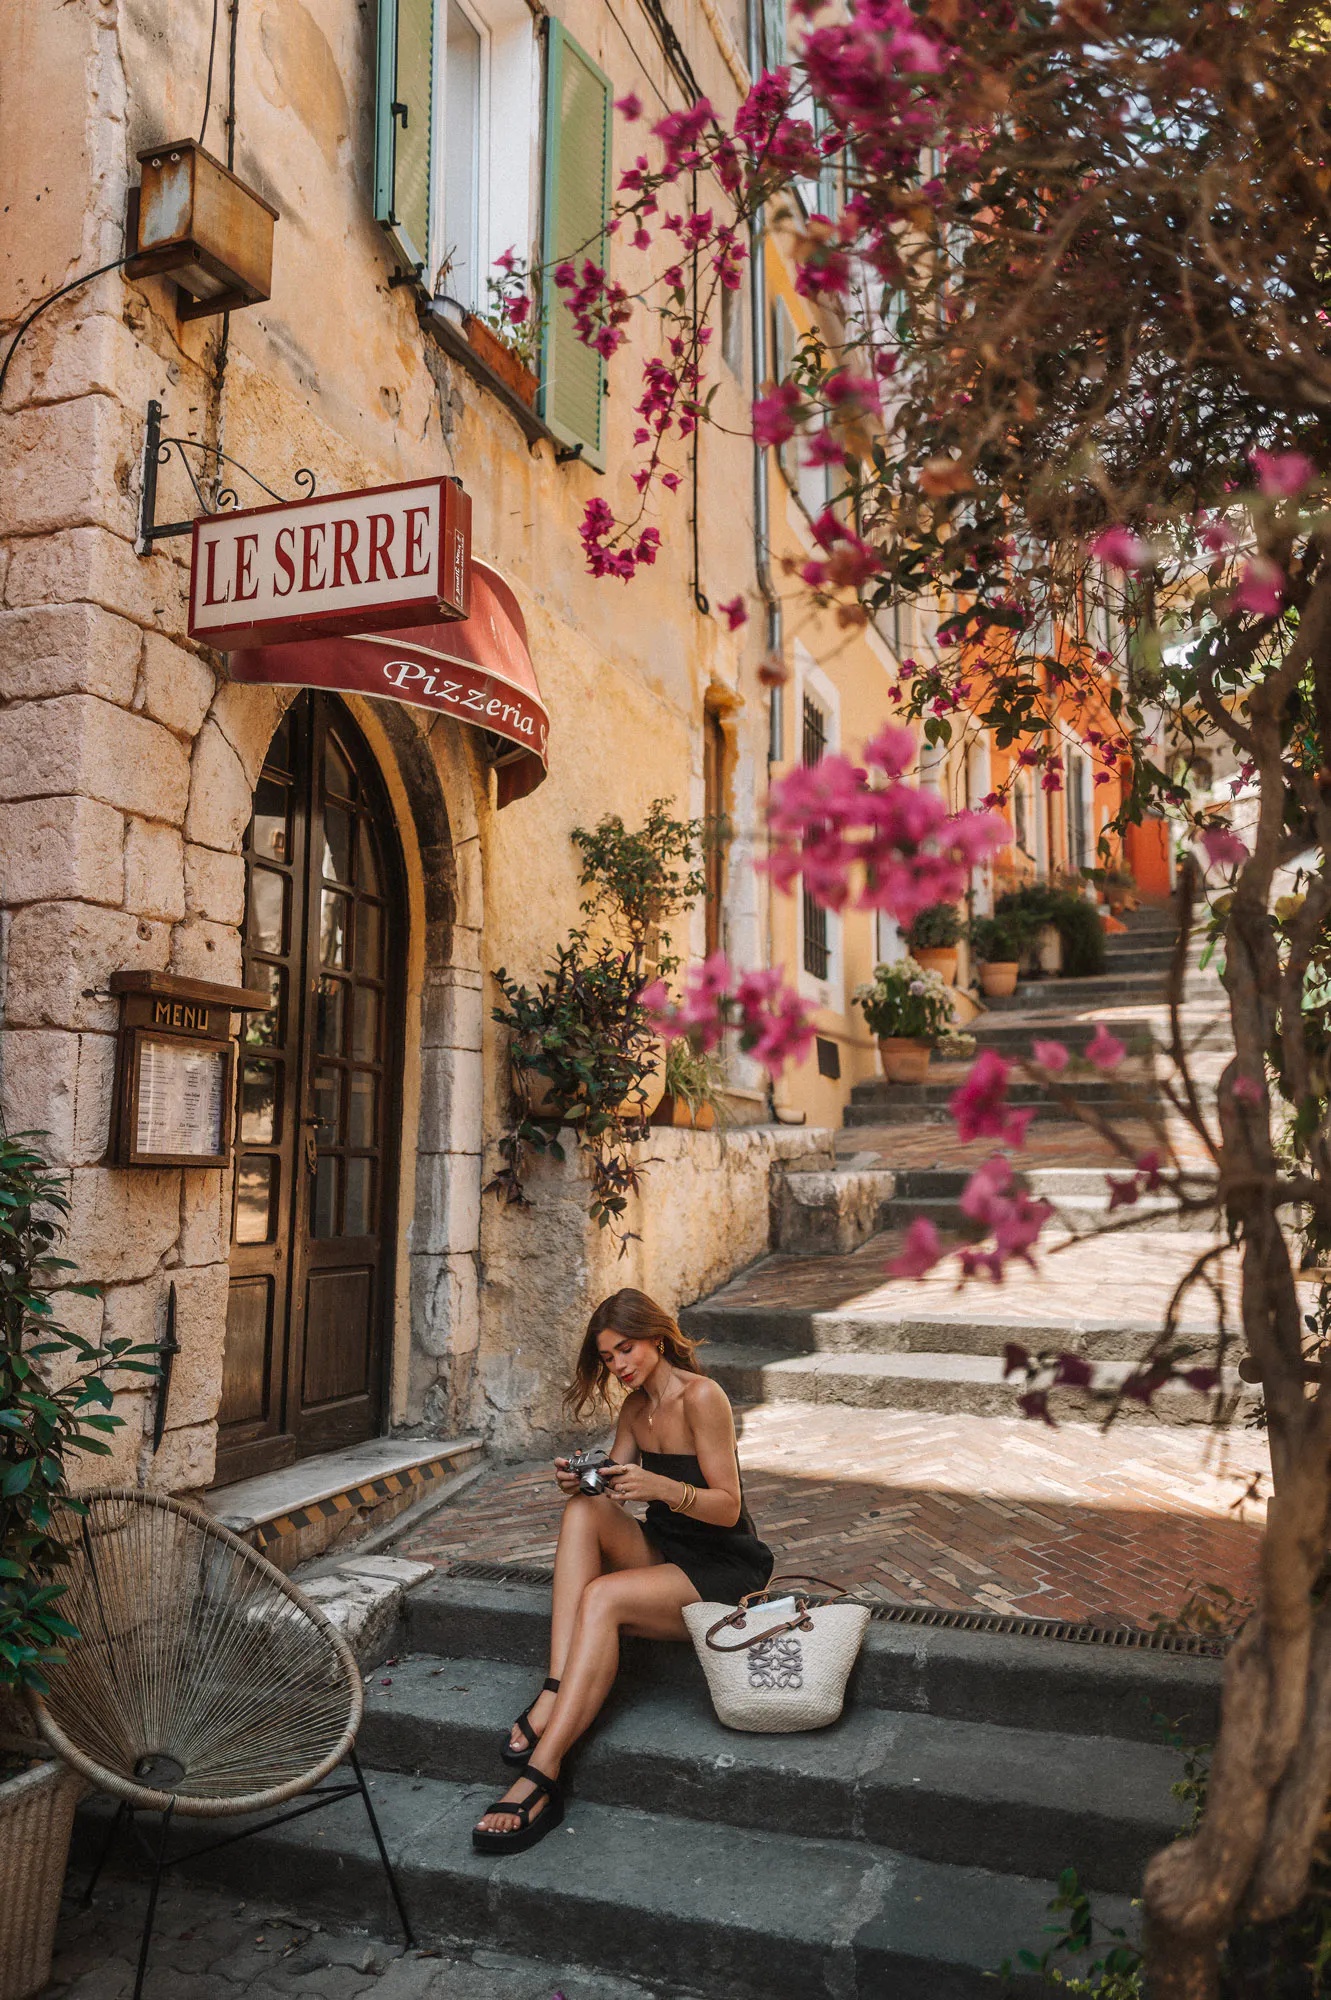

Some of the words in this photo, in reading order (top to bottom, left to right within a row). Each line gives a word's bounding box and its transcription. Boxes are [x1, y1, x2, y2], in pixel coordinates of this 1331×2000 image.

[202, 533, 259, 607] LE
[273, 506, 431, 598] SERRE
[383, 660, 535, 736] Pizzeria
[155, 1000, 209, 1031] MENU
